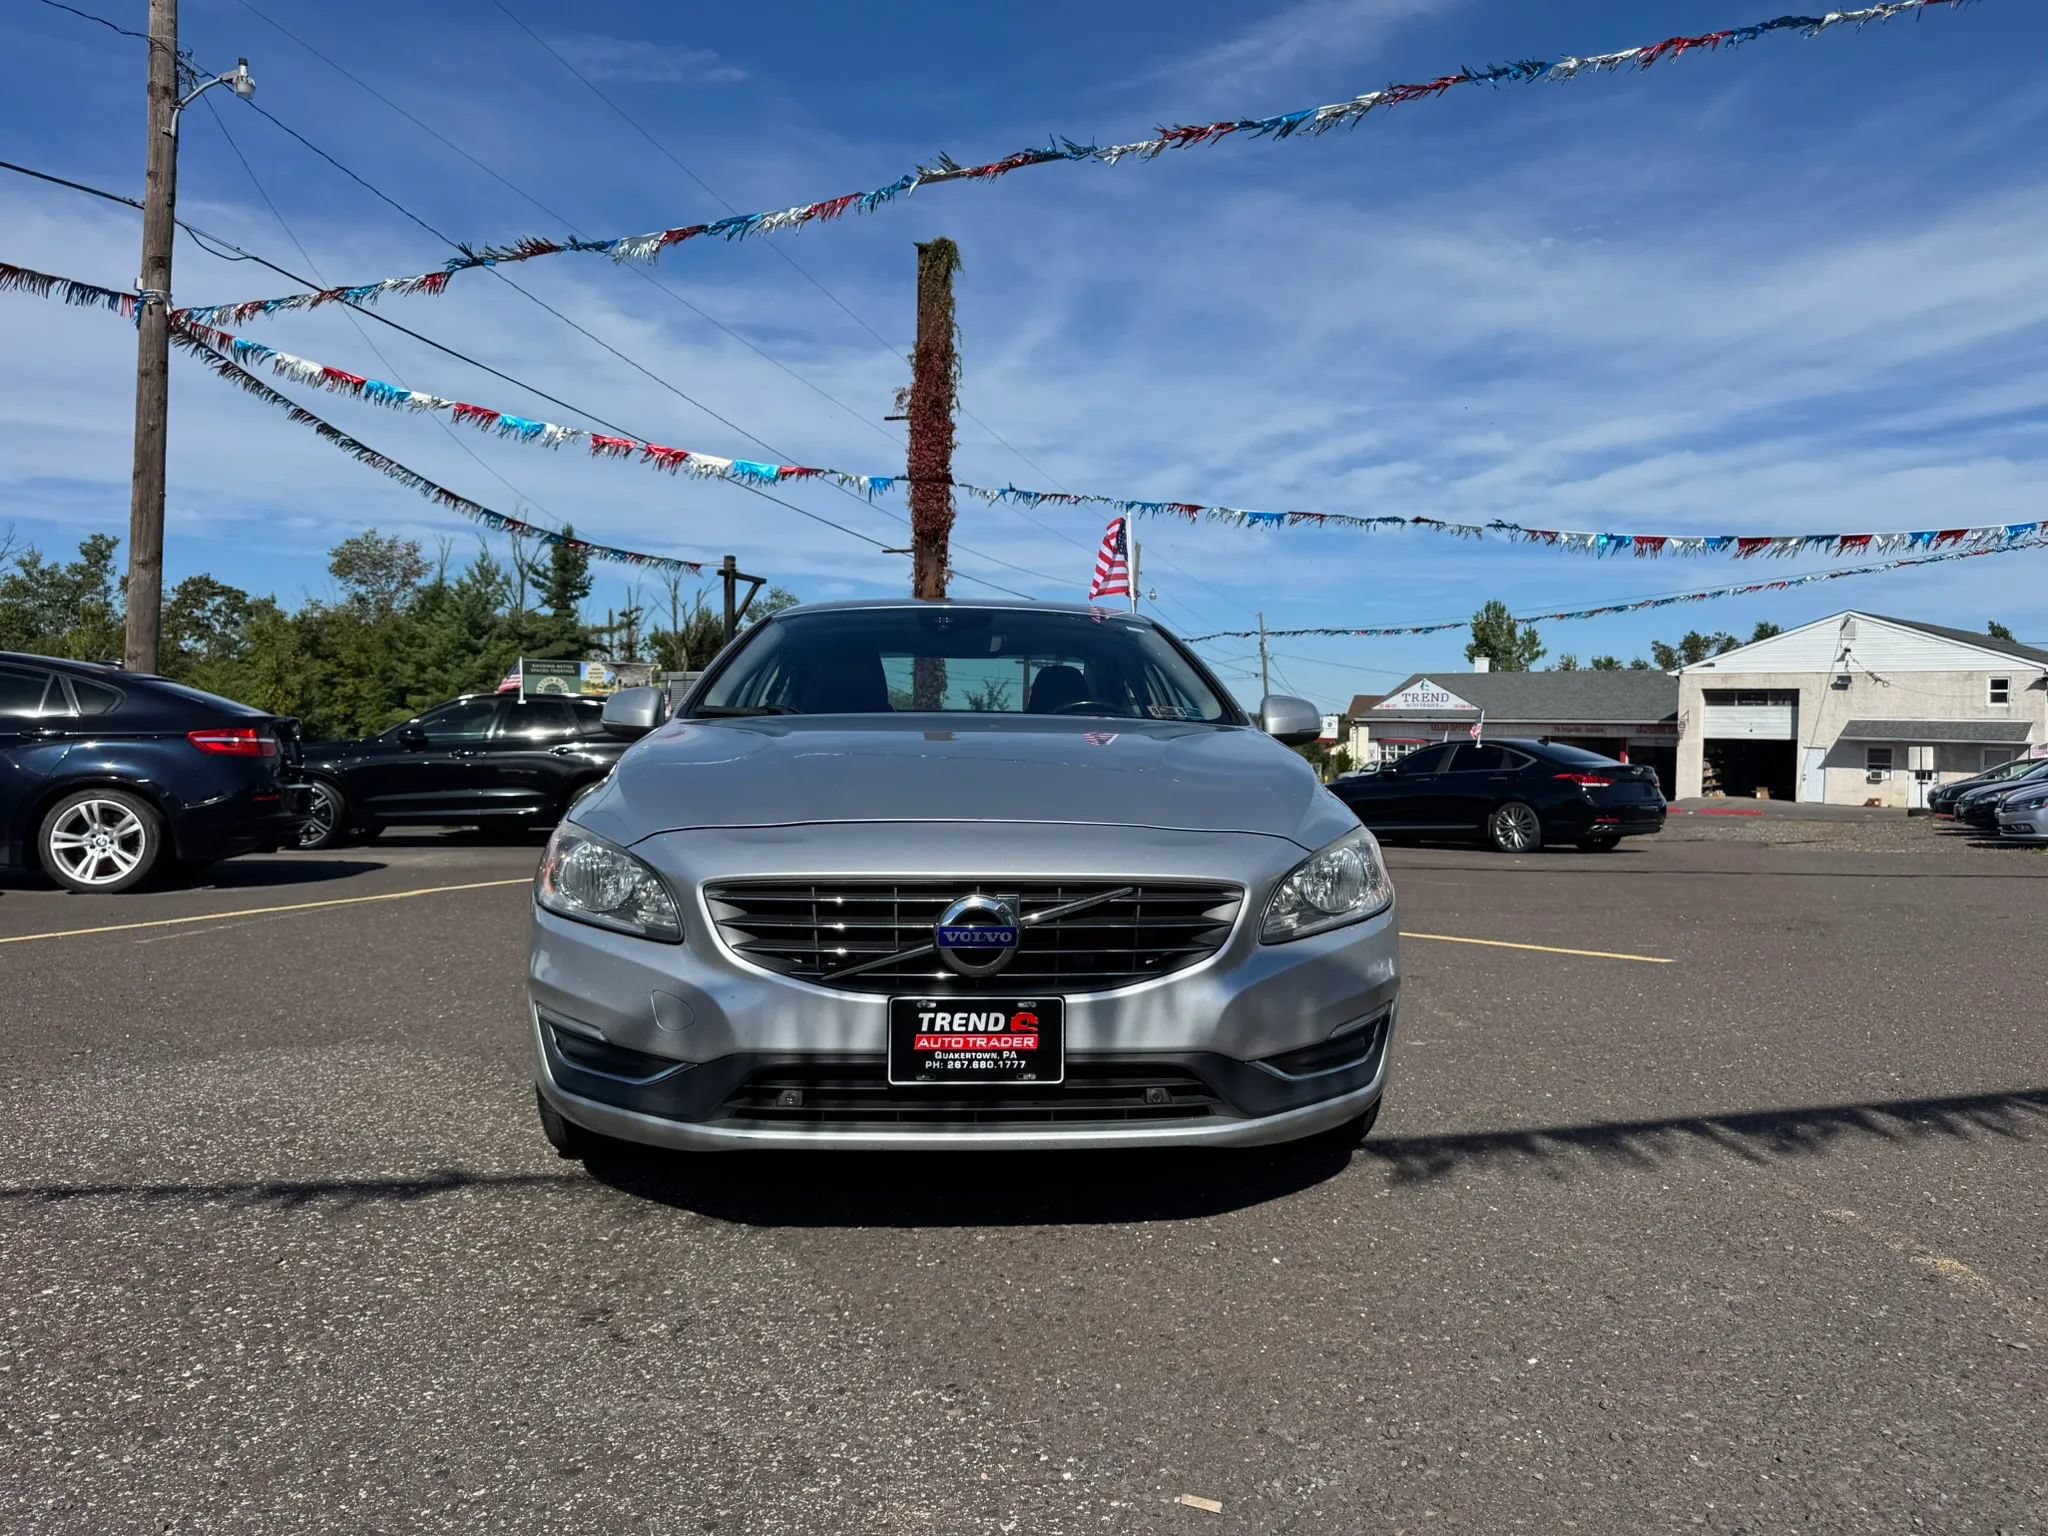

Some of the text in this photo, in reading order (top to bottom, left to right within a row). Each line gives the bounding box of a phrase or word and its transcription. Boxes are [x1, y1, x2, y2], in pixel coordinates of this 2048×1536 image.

[1401, 692, 1450, 703] TREND
[943, 931, 1012, 942] VOLVO
[918, 1012, 1006, 1032] TREND
[917, 1036, 1035, 1048] AUTO TRADER
[1002, 1051, 1017, 1059] PA
[925, 1060, 1026, 1069] PH: 267.680.1777
